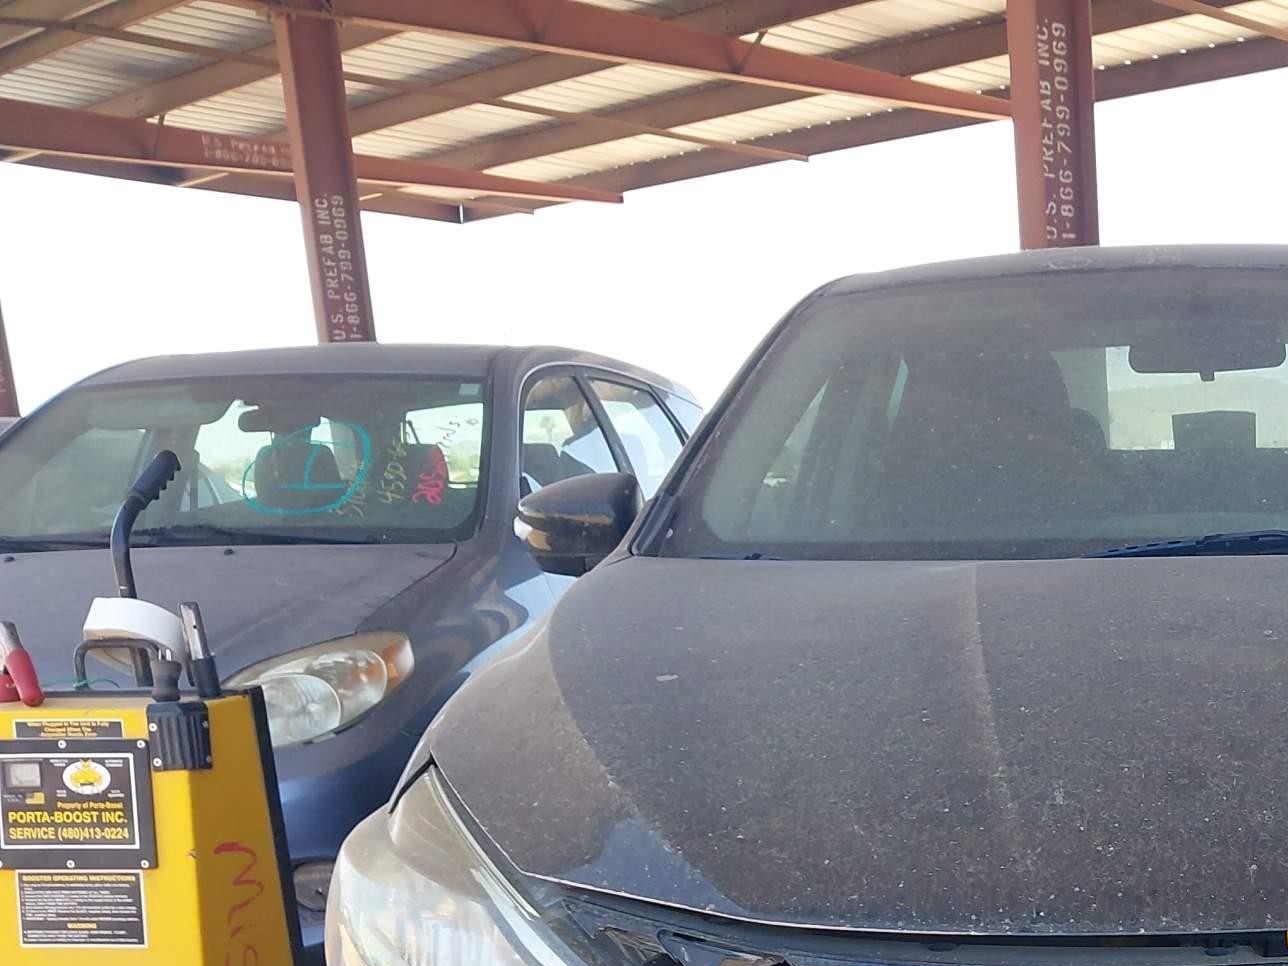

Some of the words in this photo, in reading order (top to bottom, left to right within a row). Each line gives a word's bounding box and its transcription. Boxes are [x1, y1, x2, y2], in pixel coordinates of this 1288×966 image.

[1052, 22, 1076, 239] 1-866-799-0969
[315, 193, 331, 225] INC.
[320, 234, 341, 299] PREFAB
[331, 195, 363, 339] 1-866-799-0969
[332, 308, 346, 340] U.S.
[8, 811, 98, 823] PORTA-BOOST
[101, 811, 128, 823] INC.
[9, 827, 56, 839] SERVICE
[58, 827, 129, 841] (480)413-0224
